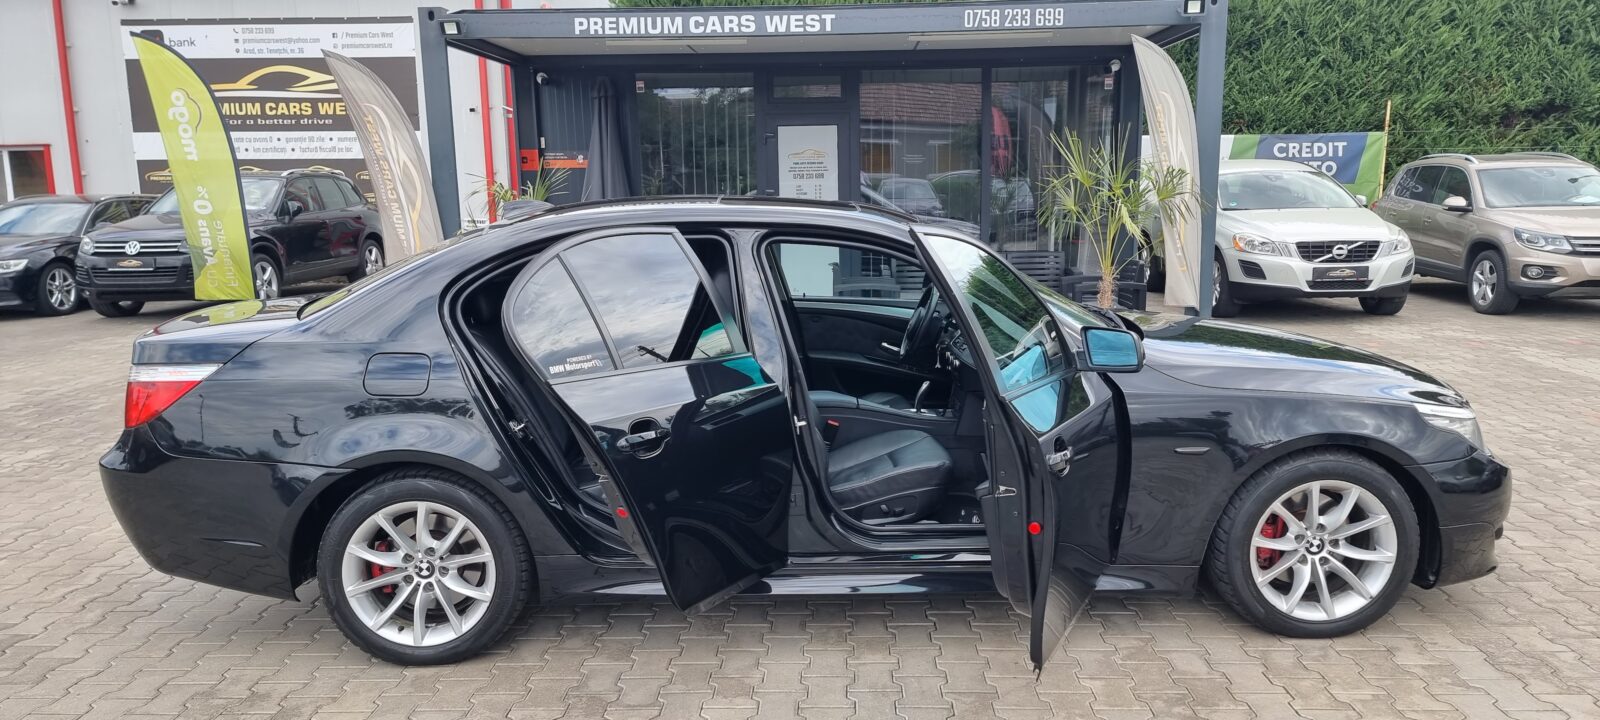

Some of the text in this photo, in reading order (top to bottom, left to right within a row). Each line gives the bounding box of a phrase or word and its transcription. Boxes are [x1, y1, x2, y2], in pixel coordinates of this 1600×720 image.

[574, 14, 836, 35] PREMIUM CARS WEST
[964, 7, 1064, 28] 0758 233 699
[169, 37, 196, 47] bank
[220, 102, 347, 116] MIUM CARS WE
[1273, 141, 1347, 158] CREDIT
[1304, 160, 1338, 177] TO
[549, 364, 565, 374] BMW
